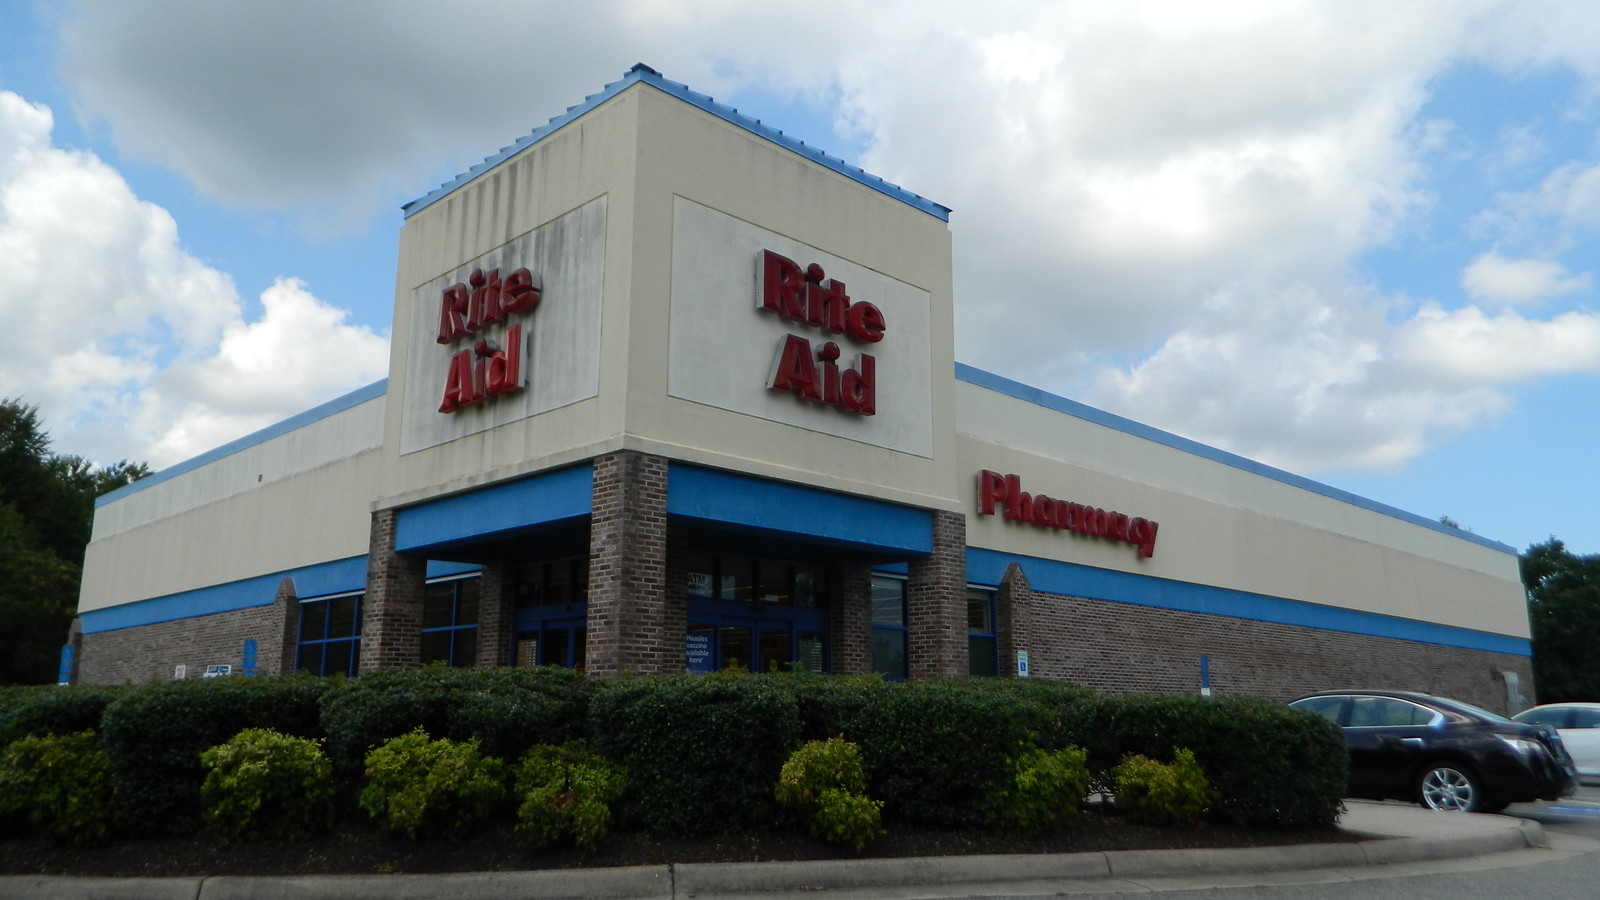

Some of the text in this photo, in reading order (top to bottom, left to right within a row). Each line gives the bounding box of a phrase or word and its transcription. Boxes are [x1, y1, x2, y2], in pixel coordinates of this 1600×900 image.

[437, 267, 541, 344] Rite
[756, 249, 886, 344] Rite
[439, 323, 526, 414] Aid
[766, 334, 875, 416] Aid
[978, 469, 1159, 558] Pharmacy
